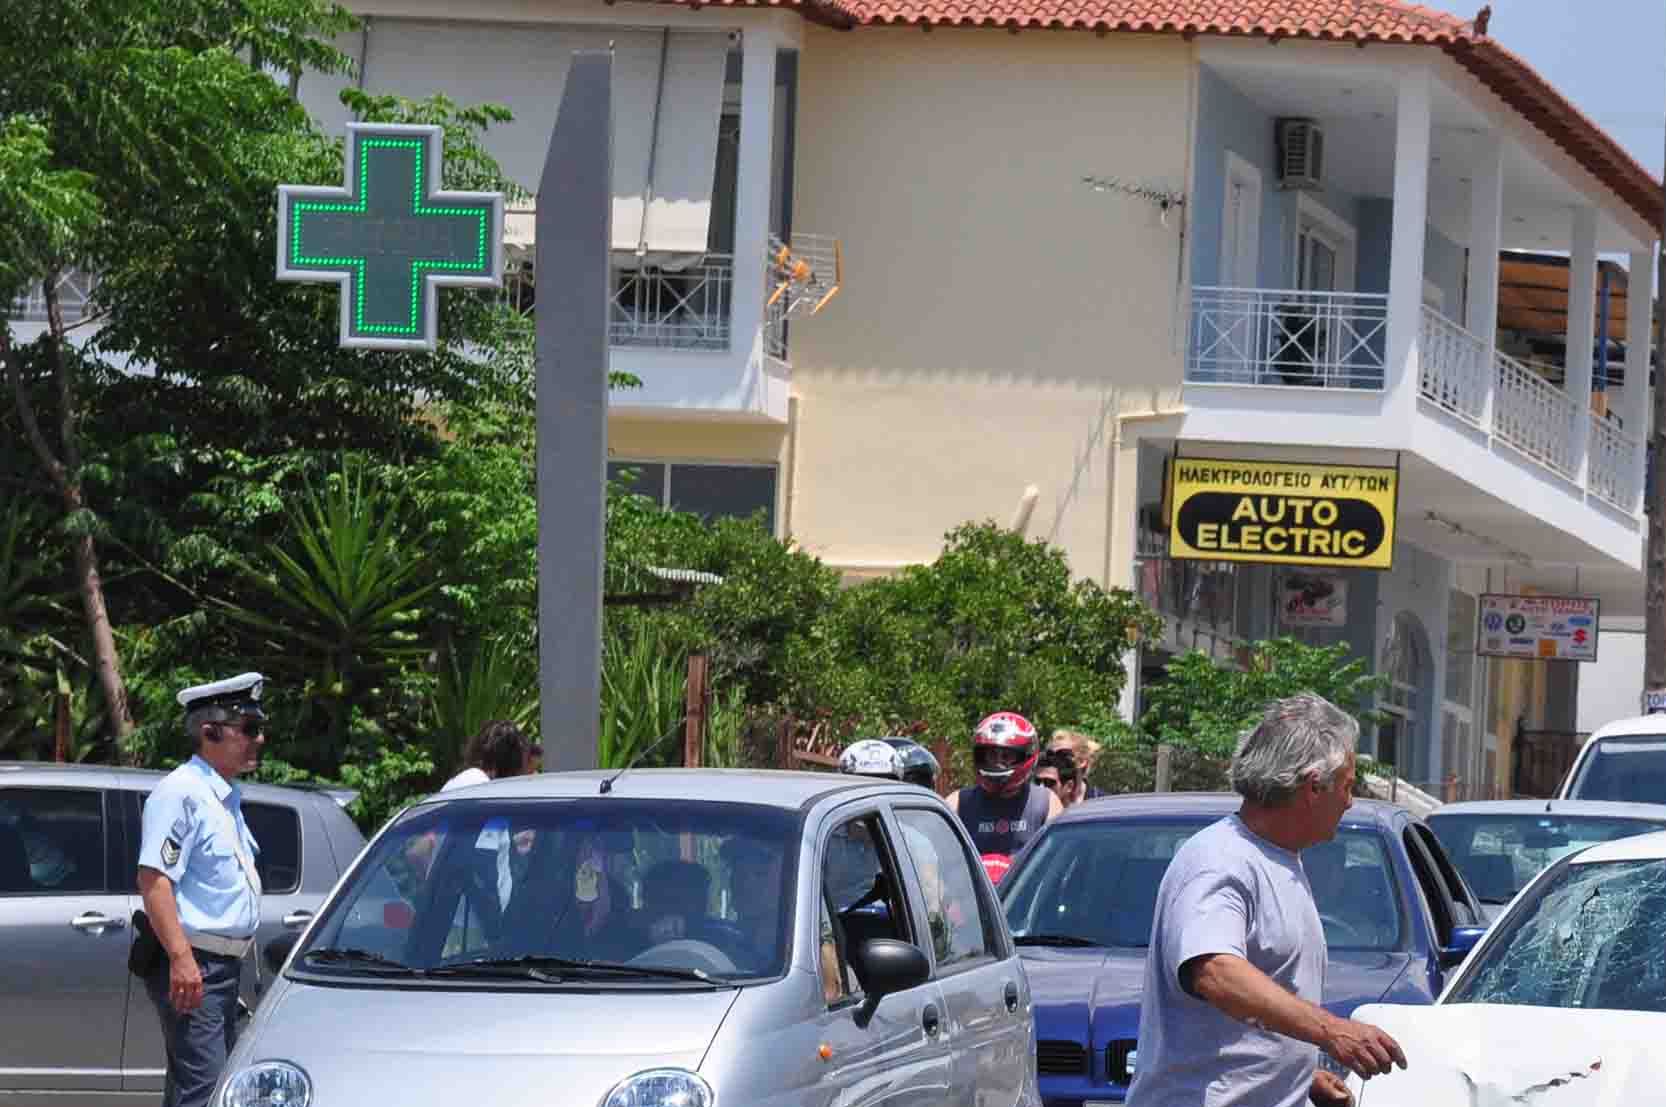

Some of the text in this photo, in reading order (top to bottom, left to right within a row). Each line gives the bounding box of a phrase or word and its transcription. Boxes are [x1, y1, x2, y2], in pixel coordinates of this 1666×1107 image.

[1179, 467, 1311, 488] ΗΛΕΚΤΡΟΛΟΓΕΙΟ
[1232, 497, 1339, 526] AUTO
[1197, 522, 1366, 559] ELECTRIC
